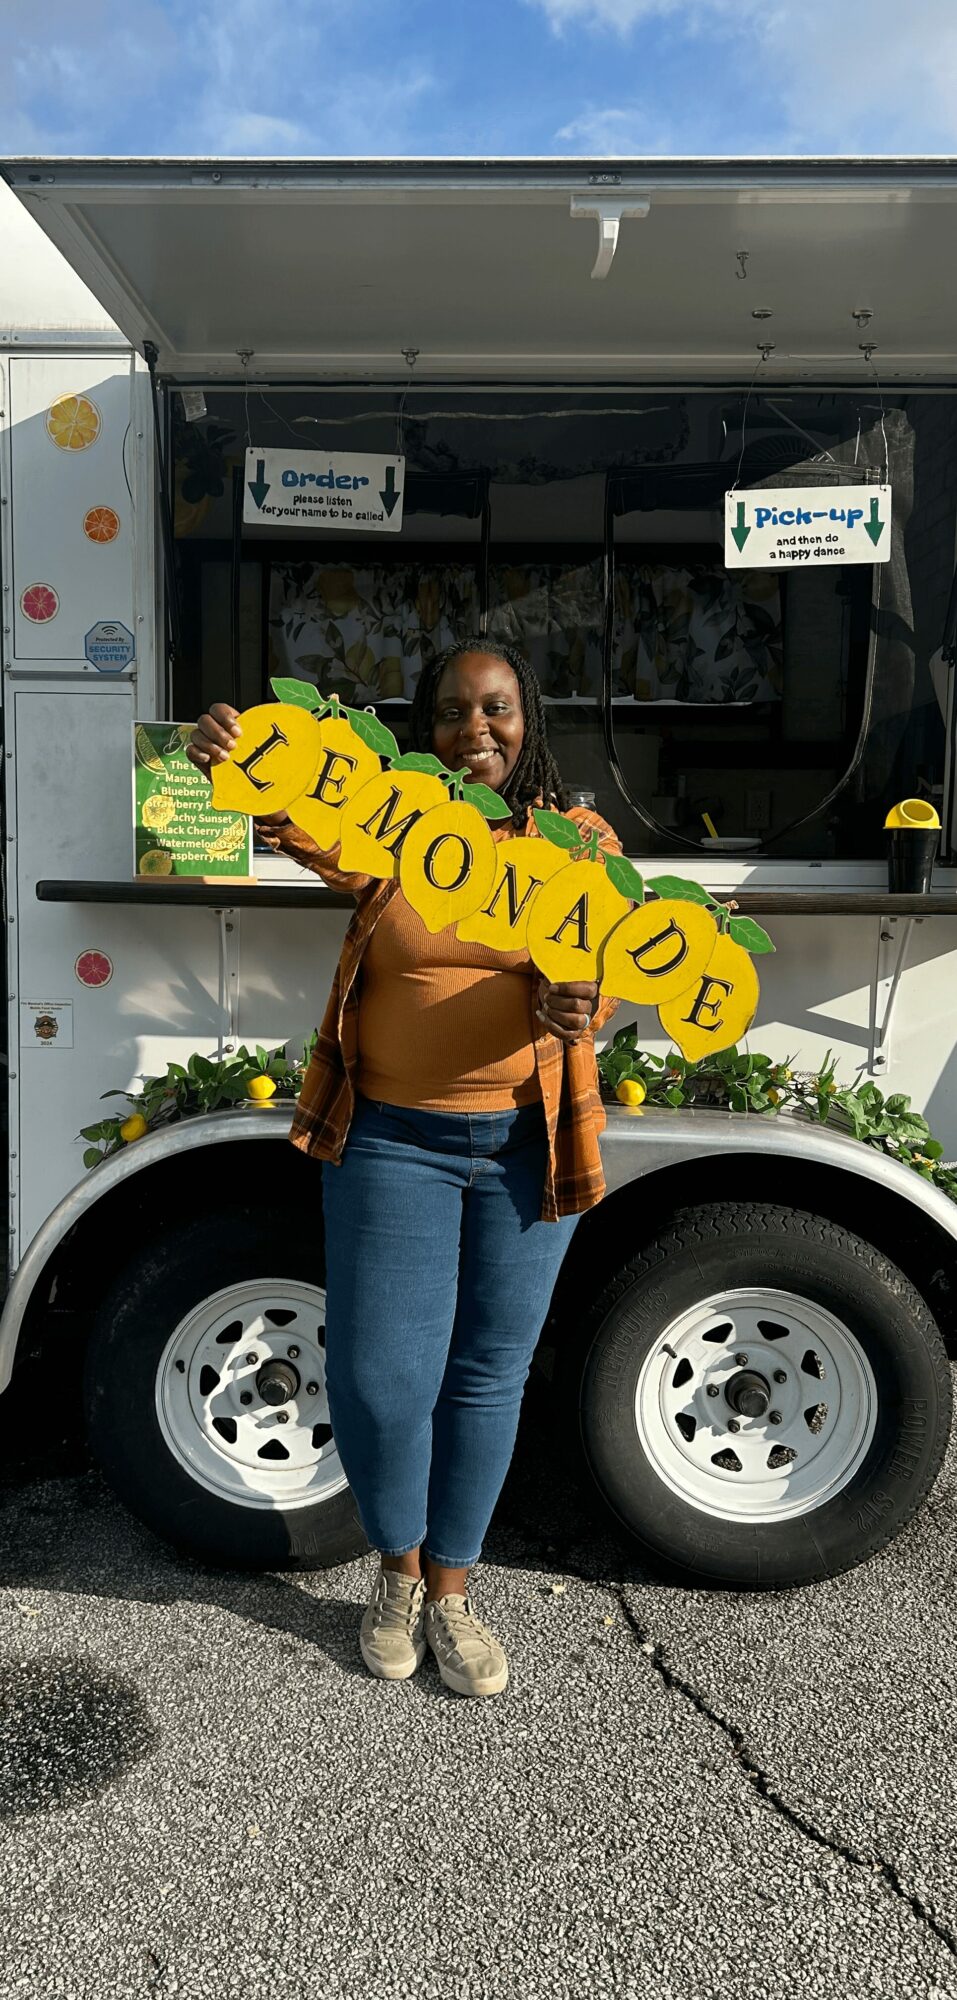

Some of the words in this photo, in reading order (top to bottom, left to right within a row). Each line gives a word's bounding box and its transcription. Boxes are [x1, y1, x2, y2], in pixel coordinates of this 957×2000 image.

[281, 469, 369, 490] Order
[293, 494, 324, 506] please
[326, 496, 353, 506] listen
[261, 504, 276, 514] for
[276, 507, 301, 517] your
[301, 508, 327, 518] name
[329, 508, 339, 518] to
[341, 509, 353, 519] be
[355, 511, 384, 521] called
[754, 507, 864, 529] Pick-up
[776, 535, 797, 546] and
[798, 535, 822, 545] then
[825, 533, 839, 543] do
[769, 551, 776, 559] a
[778, 549, 811, 560] happy
[813, 546, 846, 558] dance
[89, 645, 131, 653] SECURITY
[170, 760, 189, 770] The
[165, 773, 199, 786] Mango
[161, 786, 210, 799] Blueberry
[147, 799, 203, 811] Strawberry
[198, 813, 233, 824] Sunset
[157, 825, 185, 835] Black
[186, 825, 221, 838] Cherry
[156, 838, 217, 849] Watermelon
[219, 840, 246, 850] Oasis
[163, 850, 215, 863] Raspberry
[217, 852, 240, 862] Reef
[233, 722, 734, 1033] LEMONADE
[887, 1397, 928, 1481] POWER
